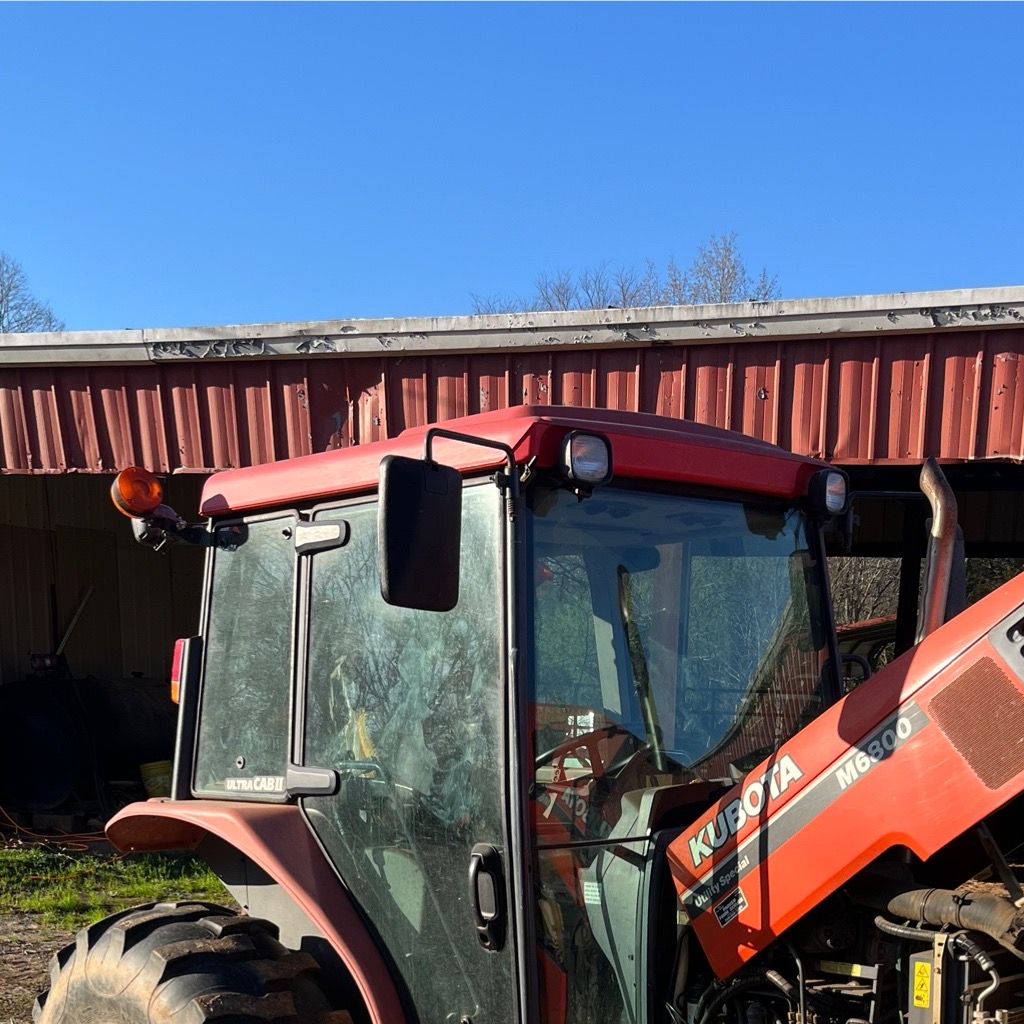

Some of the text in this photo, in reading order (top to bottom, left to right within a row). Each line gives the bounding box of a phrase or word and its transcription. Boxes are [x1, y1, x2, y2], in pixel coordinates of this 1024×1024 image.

[835, 717, 911, 790] M6800
[226, 779, 253, 791] ULTRA
[688, 753, 805, 868] KUBOTA
[694, 882, 720, 907] Utility
[719, 855, 750, 886] Special
